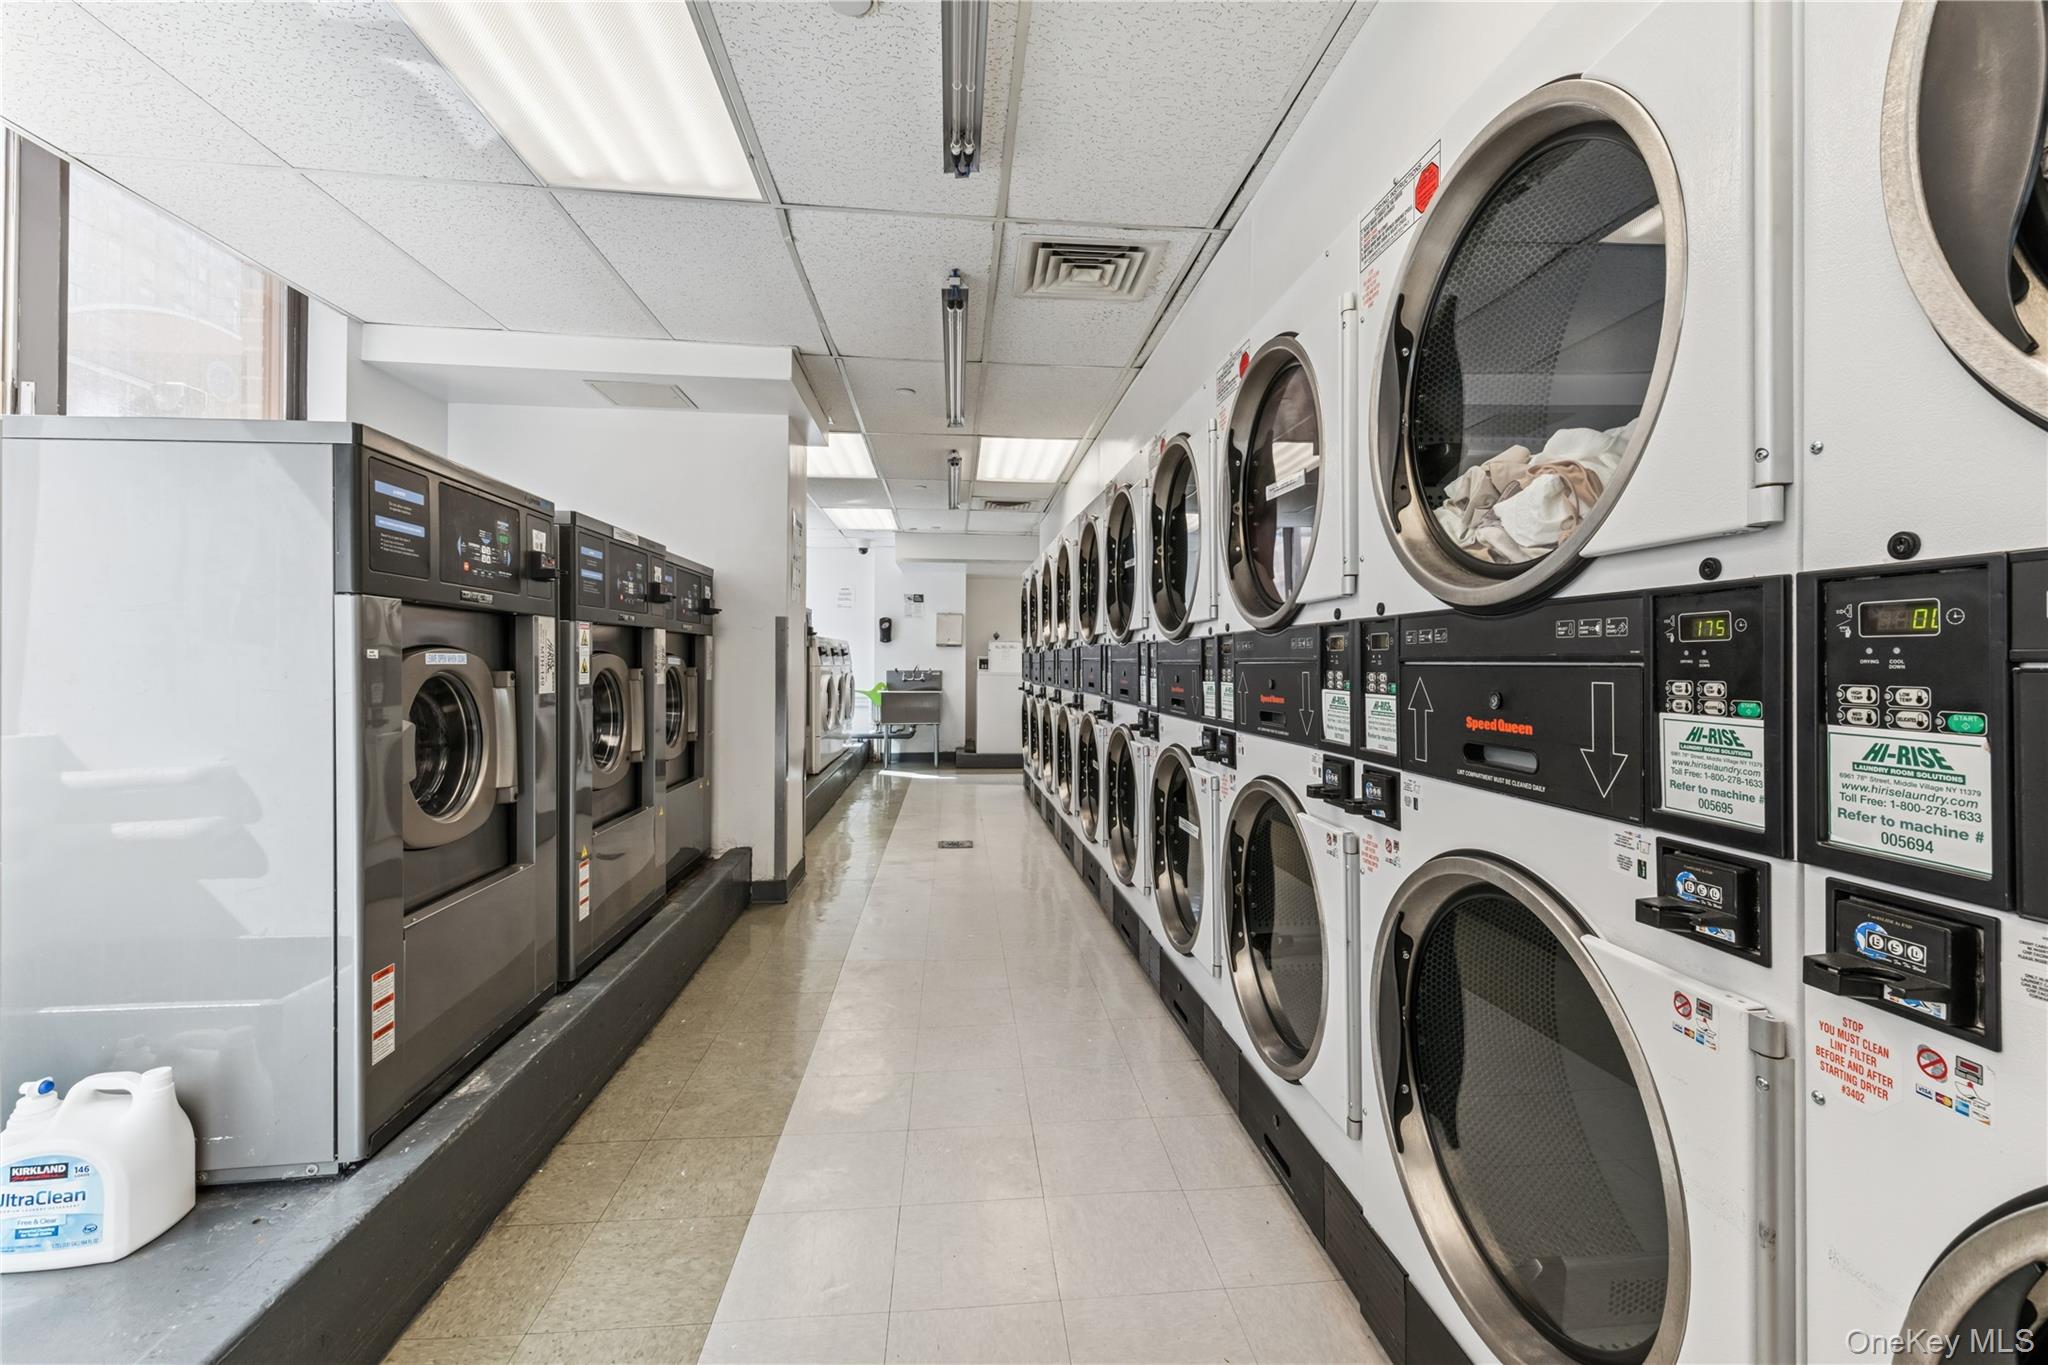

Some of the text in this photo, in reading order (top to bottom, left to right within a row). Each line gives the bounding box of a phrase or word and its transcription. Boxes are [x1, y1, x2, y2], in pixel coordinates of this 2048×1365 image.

[1697, 620, 1725, 637] 175
[1465, 715, 1533, 736] Speed Queen
[1685, 726, 1745, 748] HI-RISE
[1862, 743, 1955, 771] HI-RISE
[1671, 767, 1763, 788] Toll Free: 1-800-278-1633
[1672, 759, 1761, 777] www.hiriselaundry.com
[1854, 764, 1964, 783] LAUNDRY ROOM SOLUTIONS
[1512, 780, 1532, 790] CLEANED
[1532, 784, 1546, 793] DAILY
[1670, 779, 1696, 792] Refer
[1698, 785, 1708, 794] to
[1711, 787, 1756, 803] machine
[1841, 782, 1979, 809] www.hiriselaundry.com
[1894, 778, 1917, 788] Middle
[1919, 782, 1944, 792] Village
[1959, 788, 1981, 797] 11379
[1698, 798, 1733, 815] 005695
[1839, 792, 1982, 823] Toll Free: 1-800-278-1633
[1837, 807, 1984, 843] Refer to machine #
[1881, 832, 1934, 854] 005694
[1842, 1016, 1864, 1032] STOP
[1819, 1020, 1889, 1059] YOU MUST CLEAN
[1830, 1039, 1877, 1067] LINT FILTER
[1816, 1045, 1893, 1089] BEFORE AND AFTER
[1820, 1060, 1888, 1101] STARTING DRYER
[1841, 1085, 1865, 1104] #3402
[12, 1164, 66, 1176] KIRKLAND
